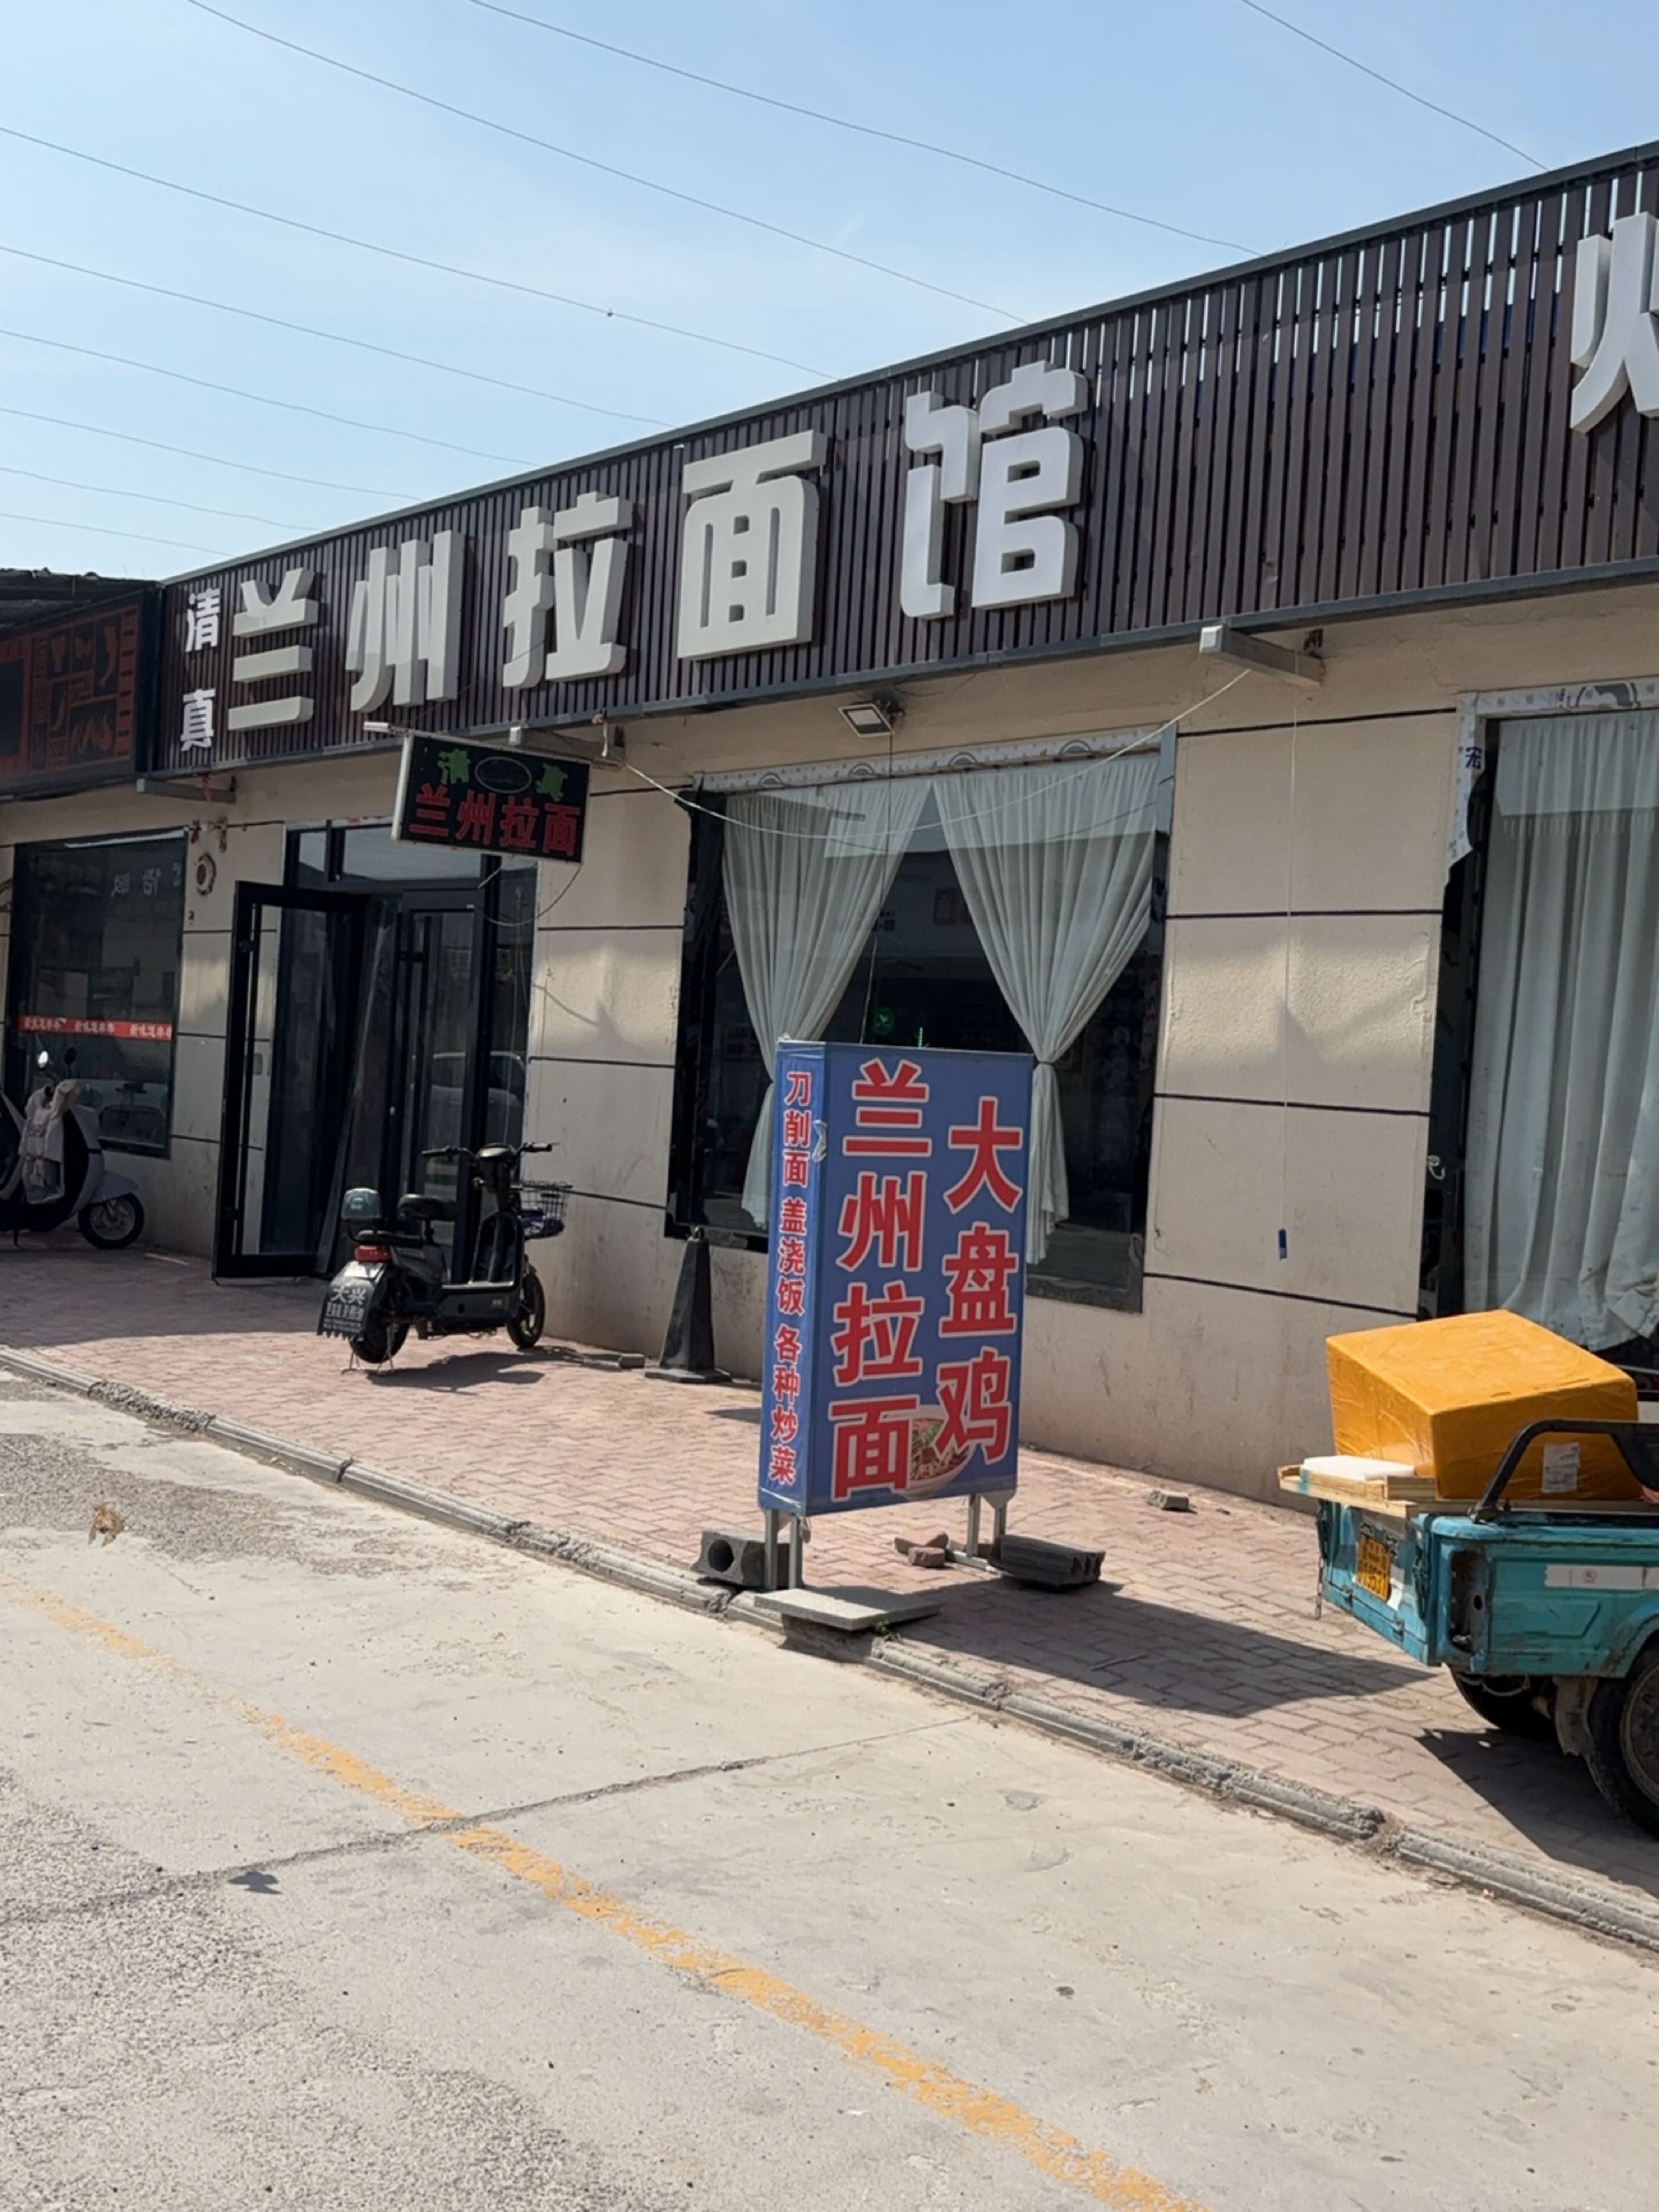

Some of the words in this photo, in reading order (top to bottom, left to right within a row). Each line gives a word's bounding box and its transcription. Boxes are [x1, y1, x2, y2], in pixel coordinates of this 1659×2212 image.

[227, 360, 1091, 731] 兰州拉面馆
[180, 588, 221, 752] 清真
[408, 782, 581, 857] 兰州拉面
[781, 1071, 812, 1187] 刀削面
[777, 1197, 807, 1316] 盖浇饭
[828, 1057, 932, 1503] 兰州拉面
[934, 1096, 1024, 1465] 大盘鸡
[770, 1325, 802, 1486] 各种炒菜
